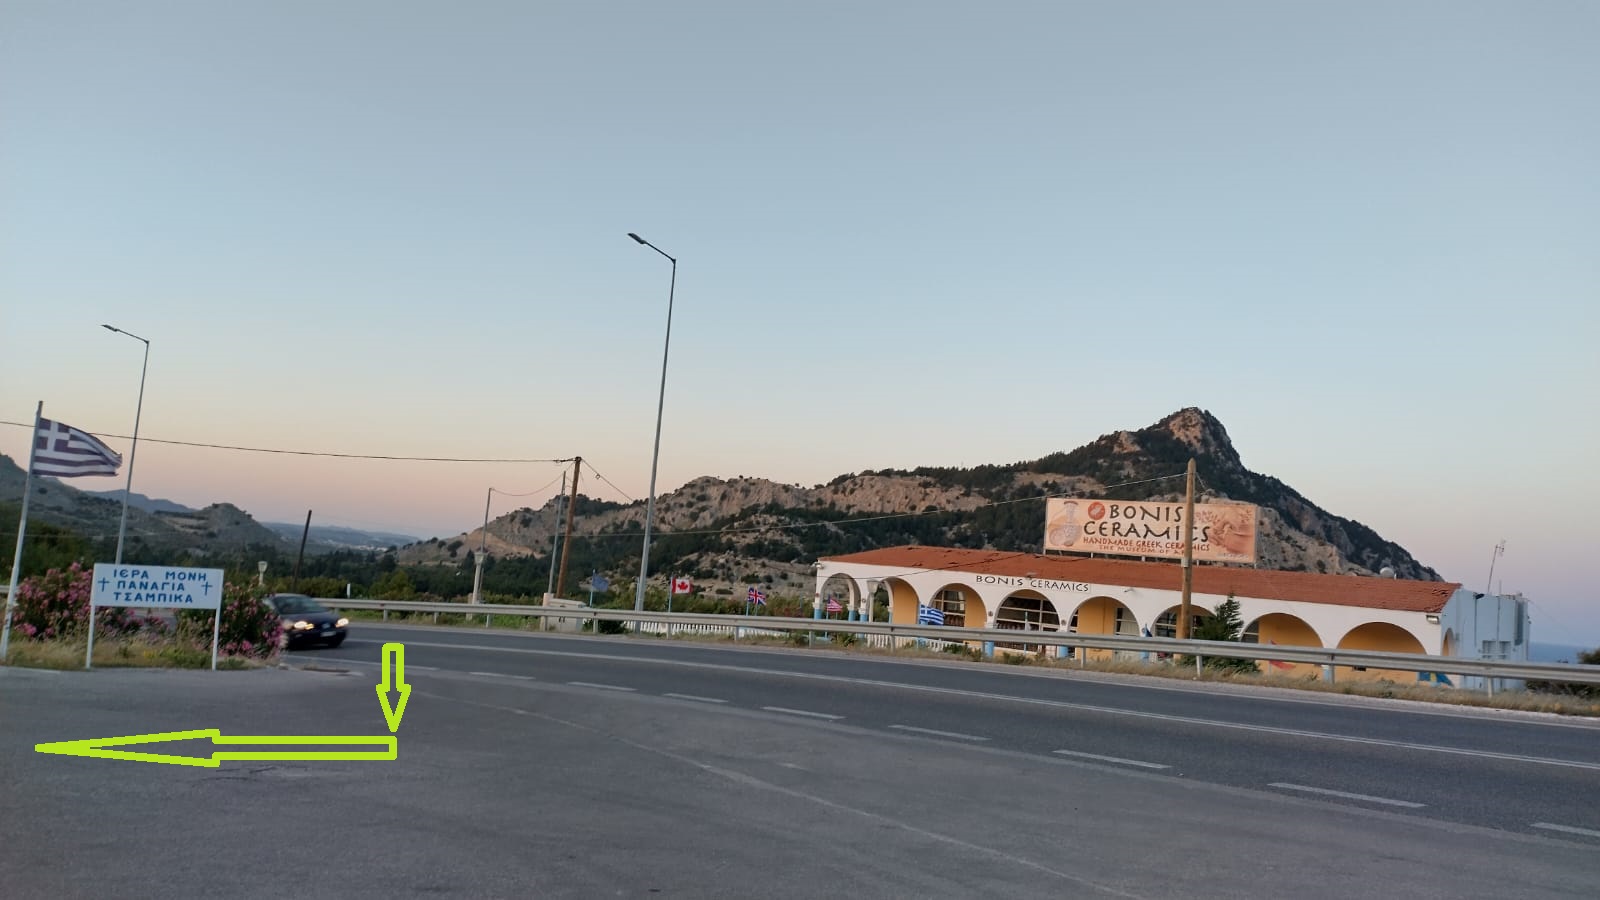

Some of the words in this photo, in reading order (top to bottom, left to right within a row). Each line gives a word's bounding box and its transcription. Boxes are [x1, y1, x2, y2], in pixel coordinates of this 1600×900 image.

[1109, 504, 1184, 522] BONIS
[1083, 536, 1133, 547] HANDMADE
[1136, 540, 1163, 550] GREEK
[165, 571, 207, 581] ΜΟΝΗ
[117, 580, 185, 591] ΠΑΝΑΓΙΑ
[976, 575, 1024, 586] BONIS
[1030, 579, 1089, 592] CERAMICS
[113, 592, 193, 603] ΤΣΑΜΠΙΚΑ
